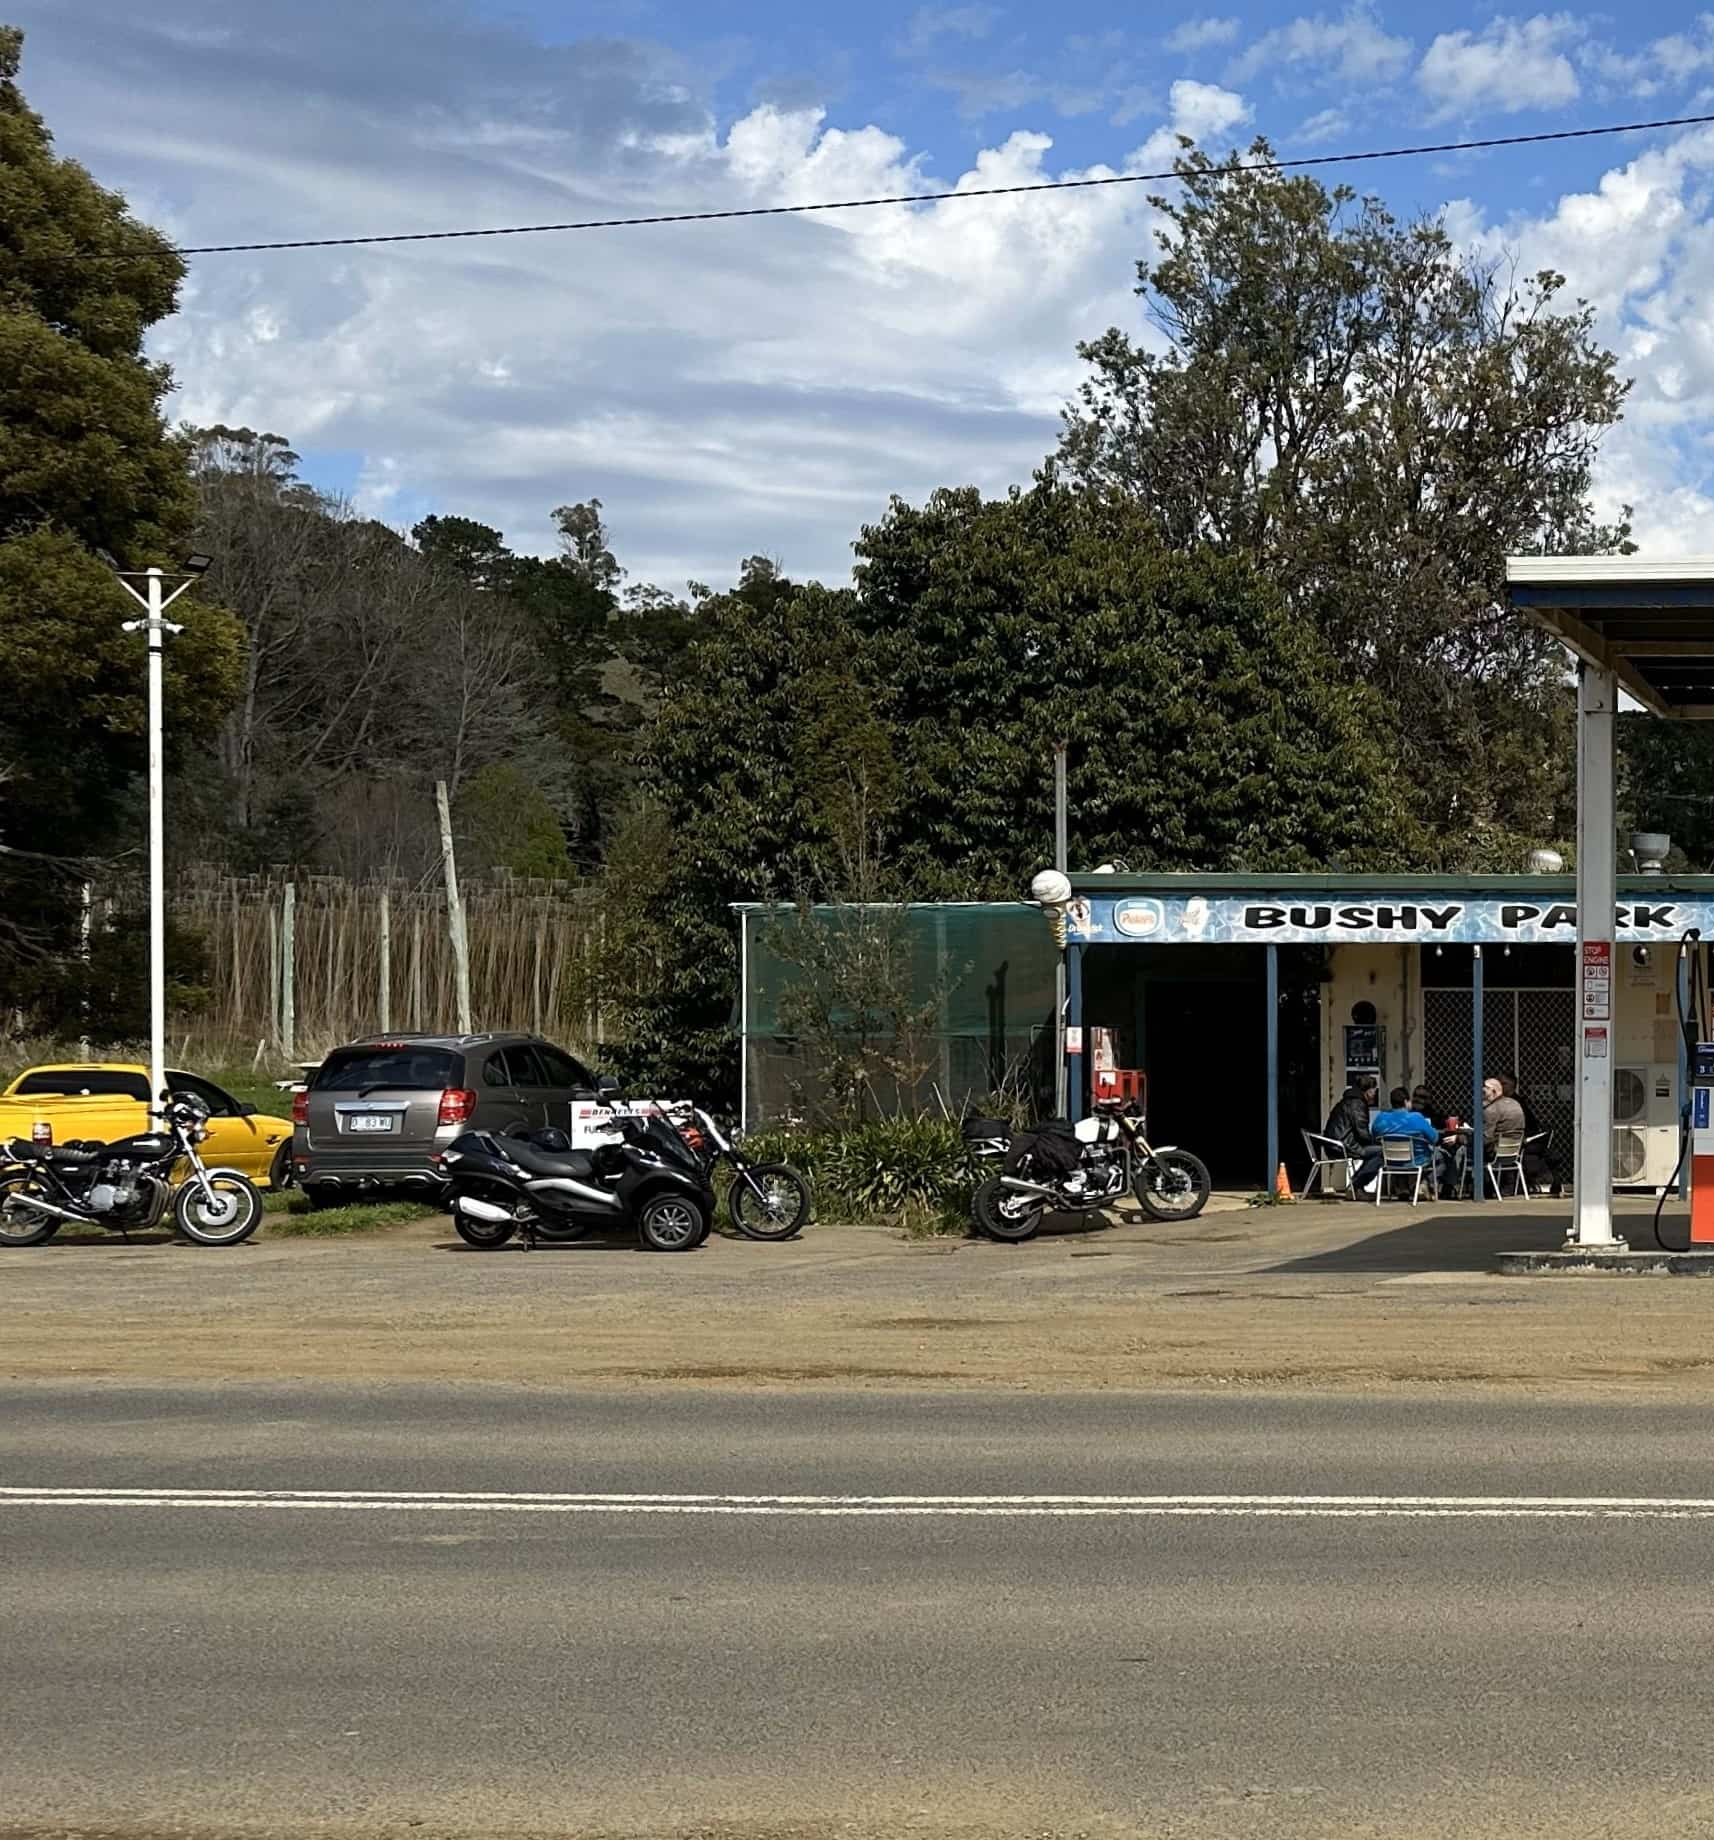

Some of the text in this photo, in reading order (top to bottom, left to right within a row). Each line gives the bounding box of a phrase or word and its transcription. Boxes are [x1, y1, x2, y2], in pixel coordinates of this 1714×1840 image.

[1244, 906, 1462, 930] BUSHY
[1584, 946, 1602, 955] STOP
[1584, 955, 1609, 965] ENGINE
